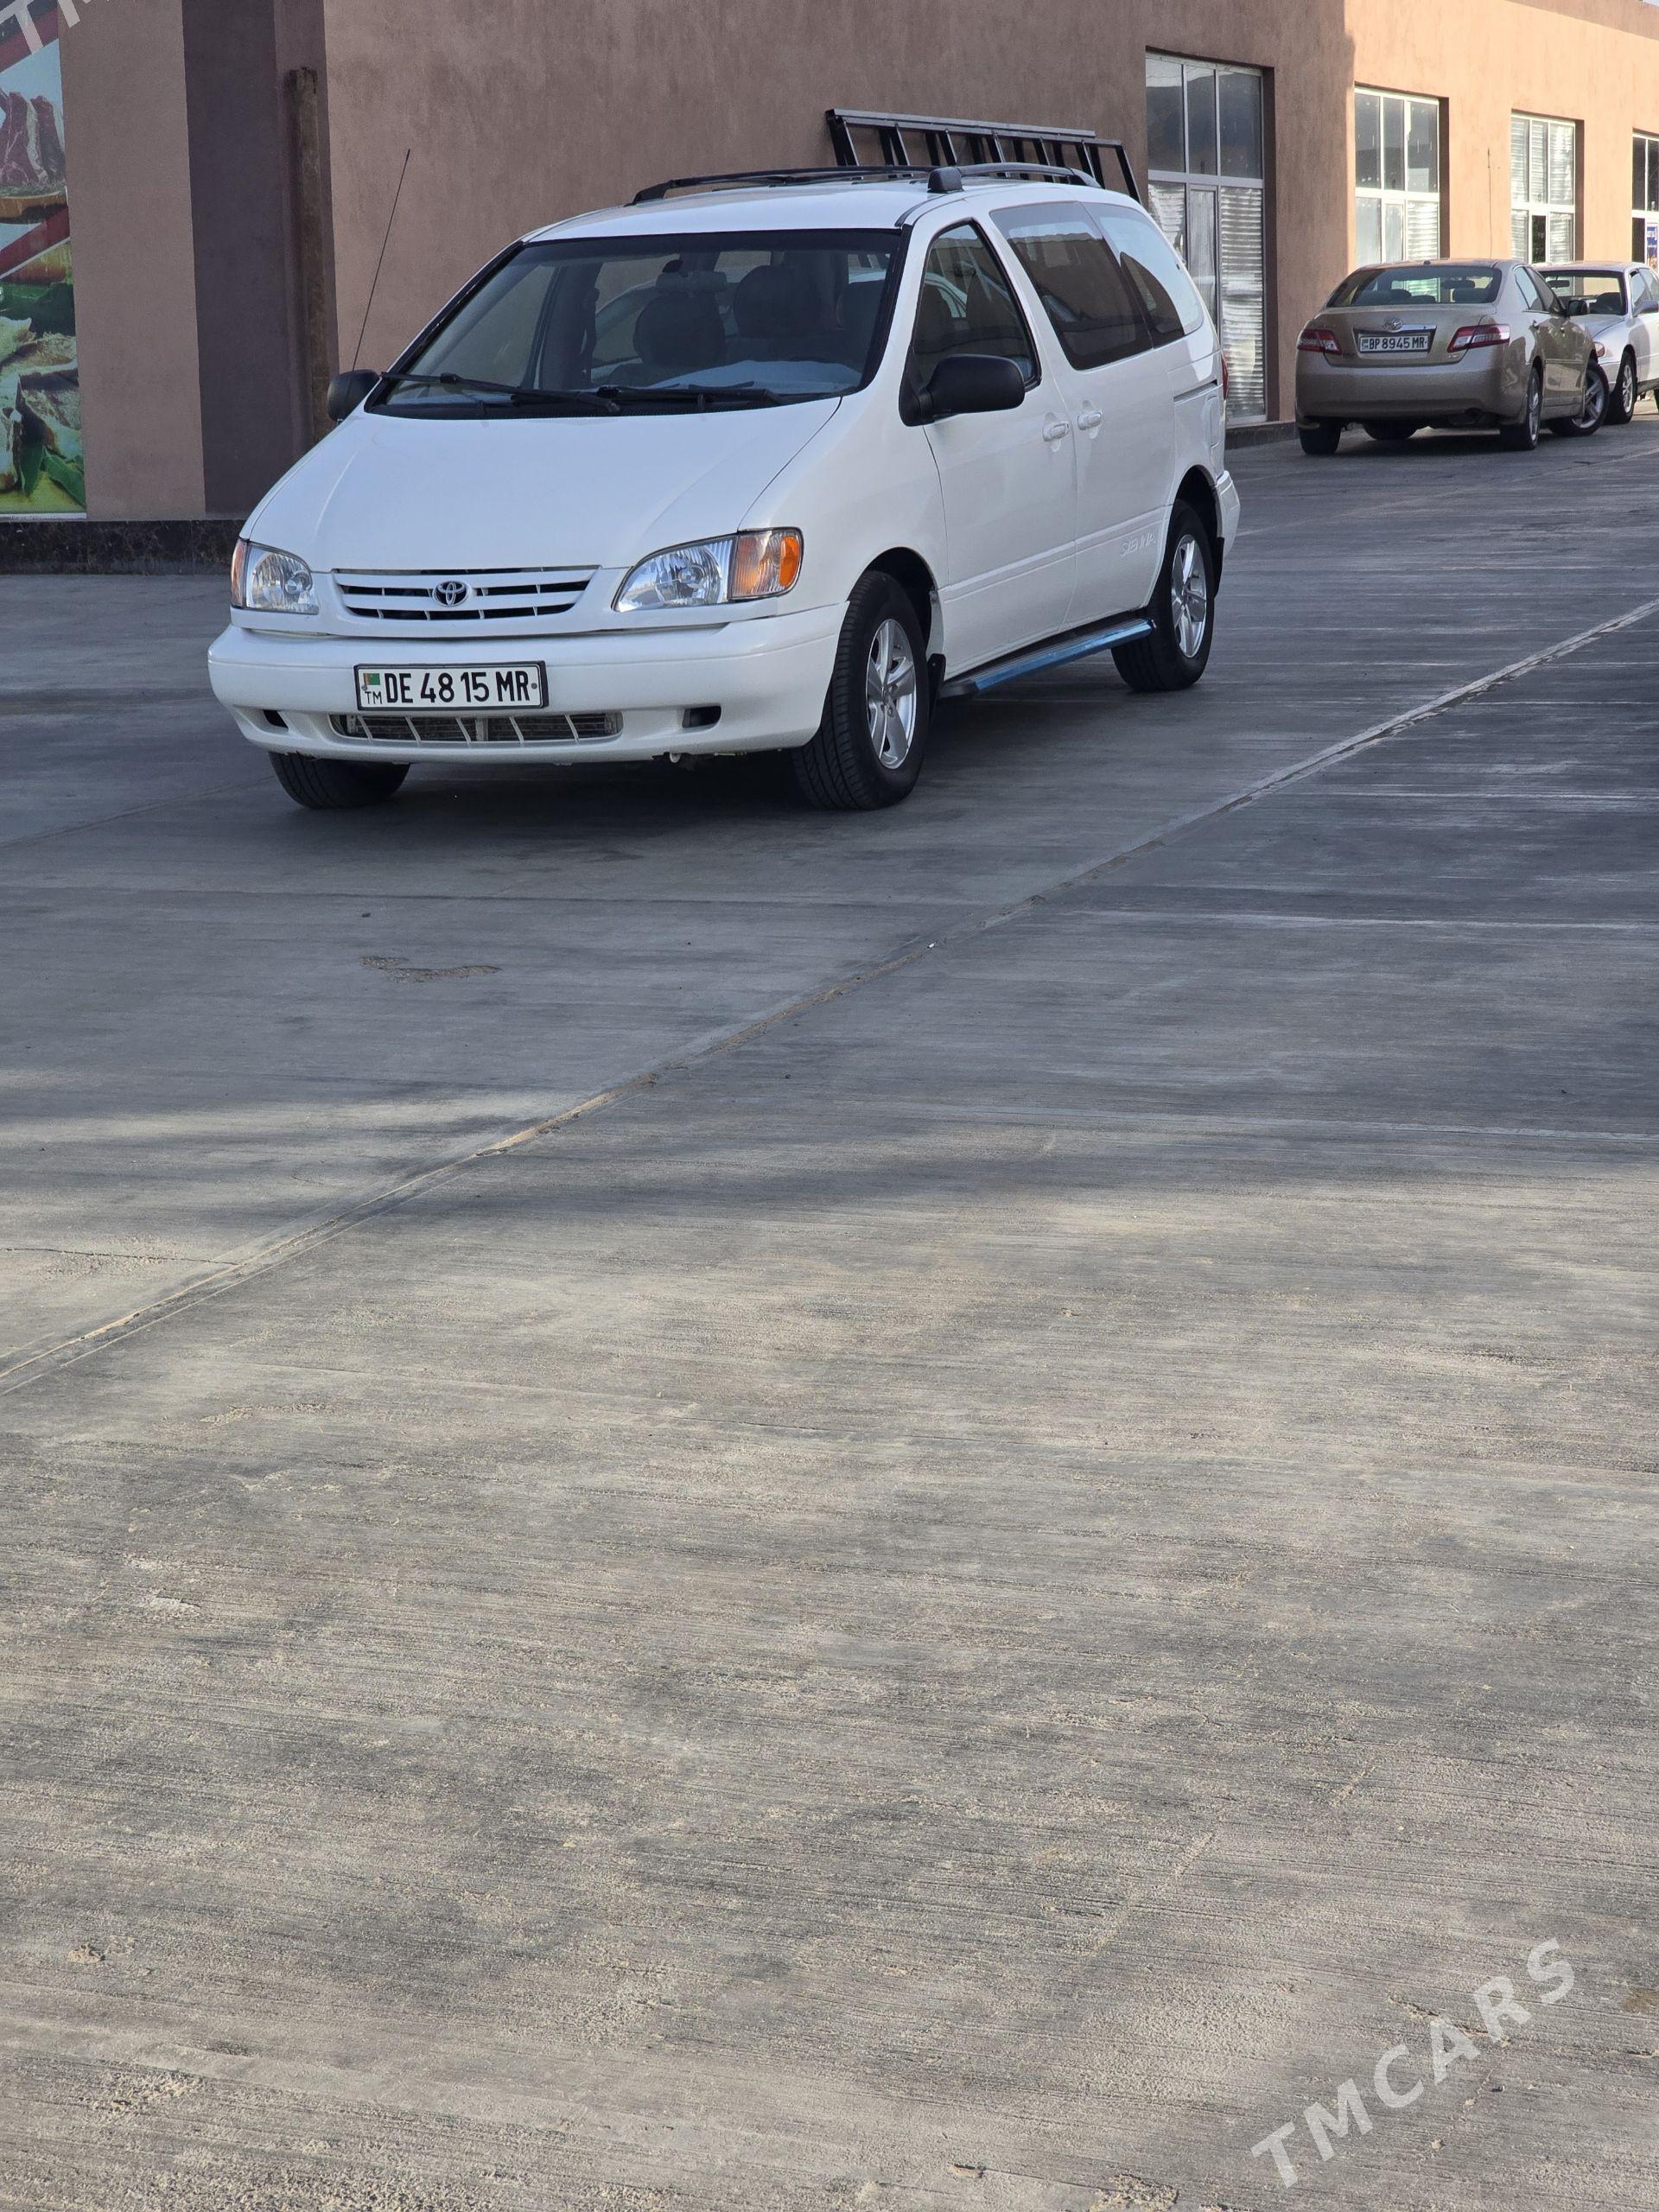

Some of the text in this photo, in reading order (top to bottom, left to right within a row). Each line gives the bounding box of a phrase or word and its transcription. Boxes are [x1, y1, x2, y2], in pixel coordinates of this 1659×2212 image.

[1369, 336, 1425, 350] BP 8945 MR
[384, 672, 414, 703] DE
[495, 671, 531, 702] MR
[365, 690, 383, 705] TM
